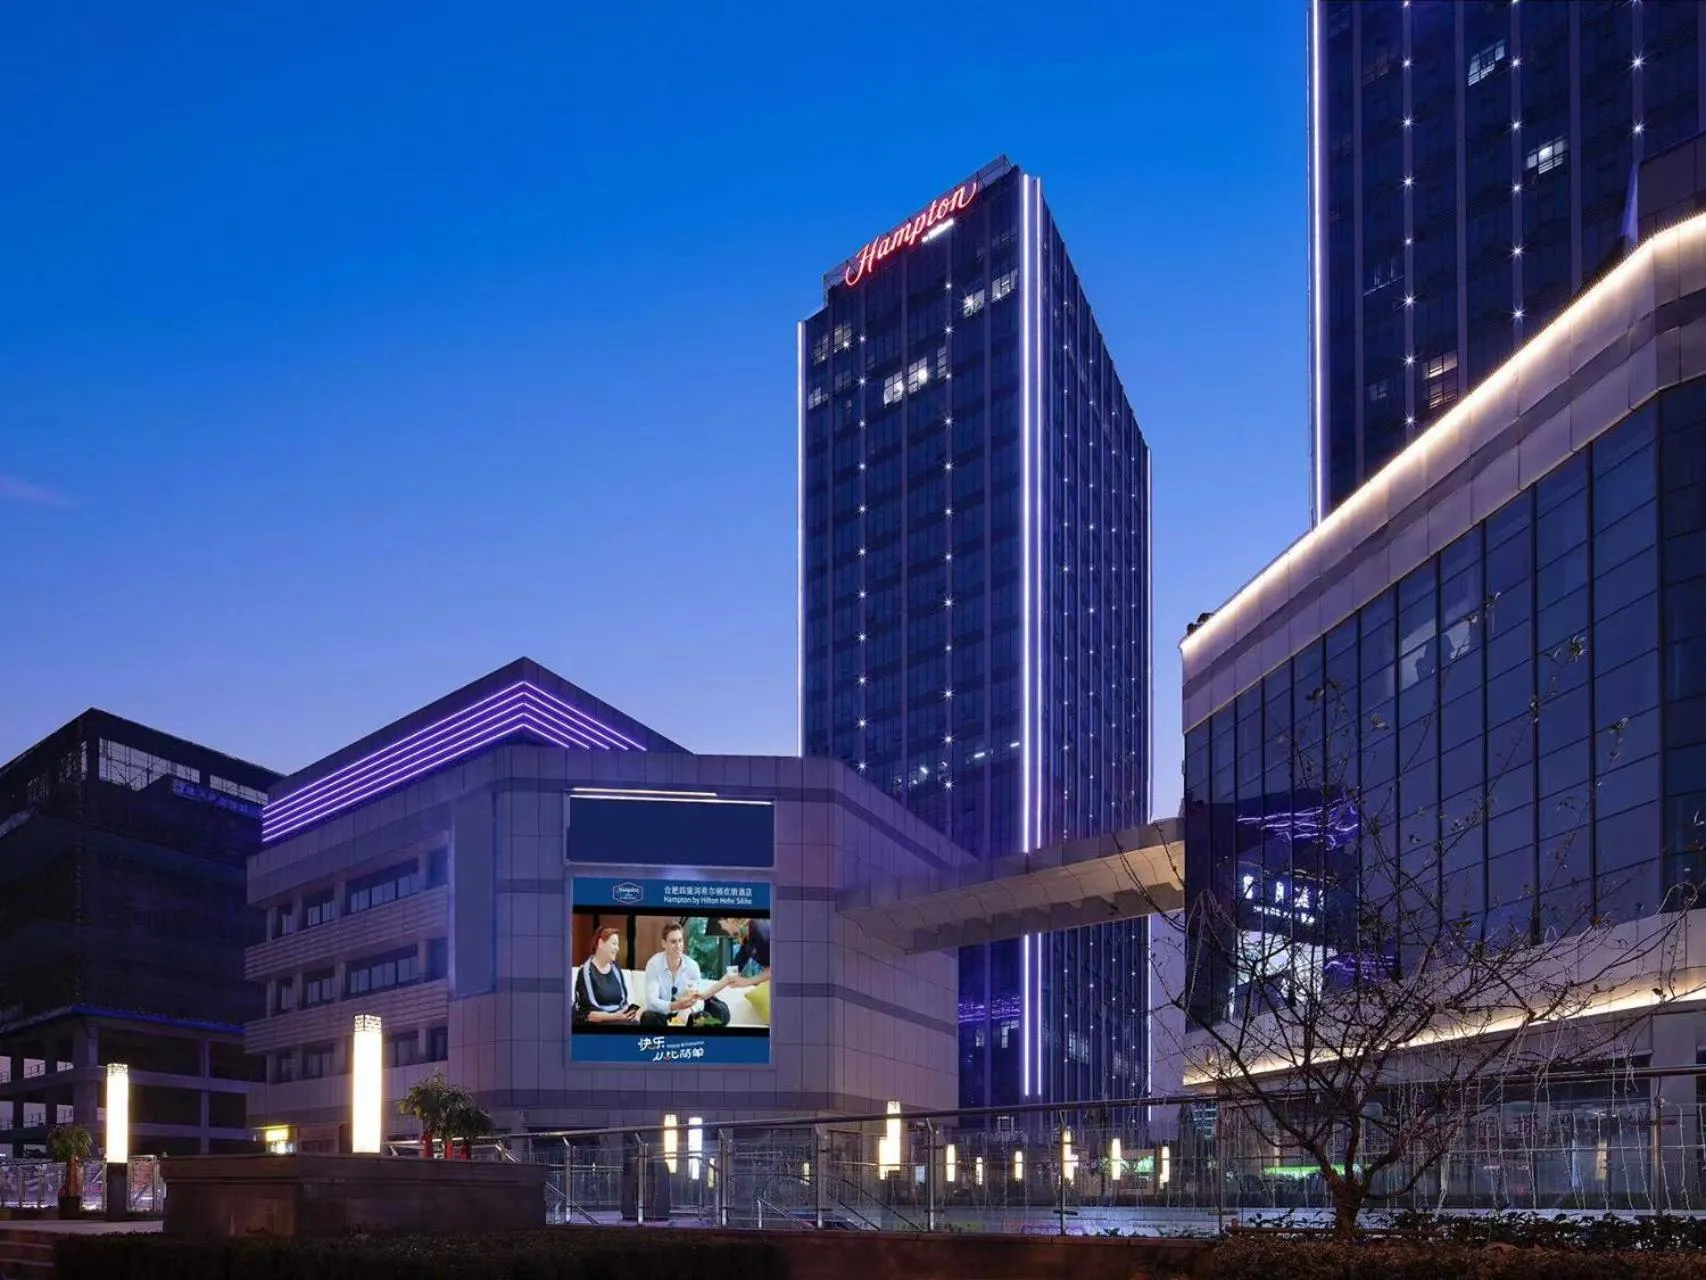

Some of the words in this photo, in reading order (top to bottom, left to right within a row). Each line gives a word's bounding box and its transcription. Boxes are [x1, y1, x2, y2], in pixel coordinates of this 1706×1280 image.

[845, 182, 977, 286] Hampton
[663, 895, 691, 905] Hampton
[692, 896, 700, 905] by
[701, 896, 719, 904] Hilton
[638, 1036, 665, 1051] 快乐
